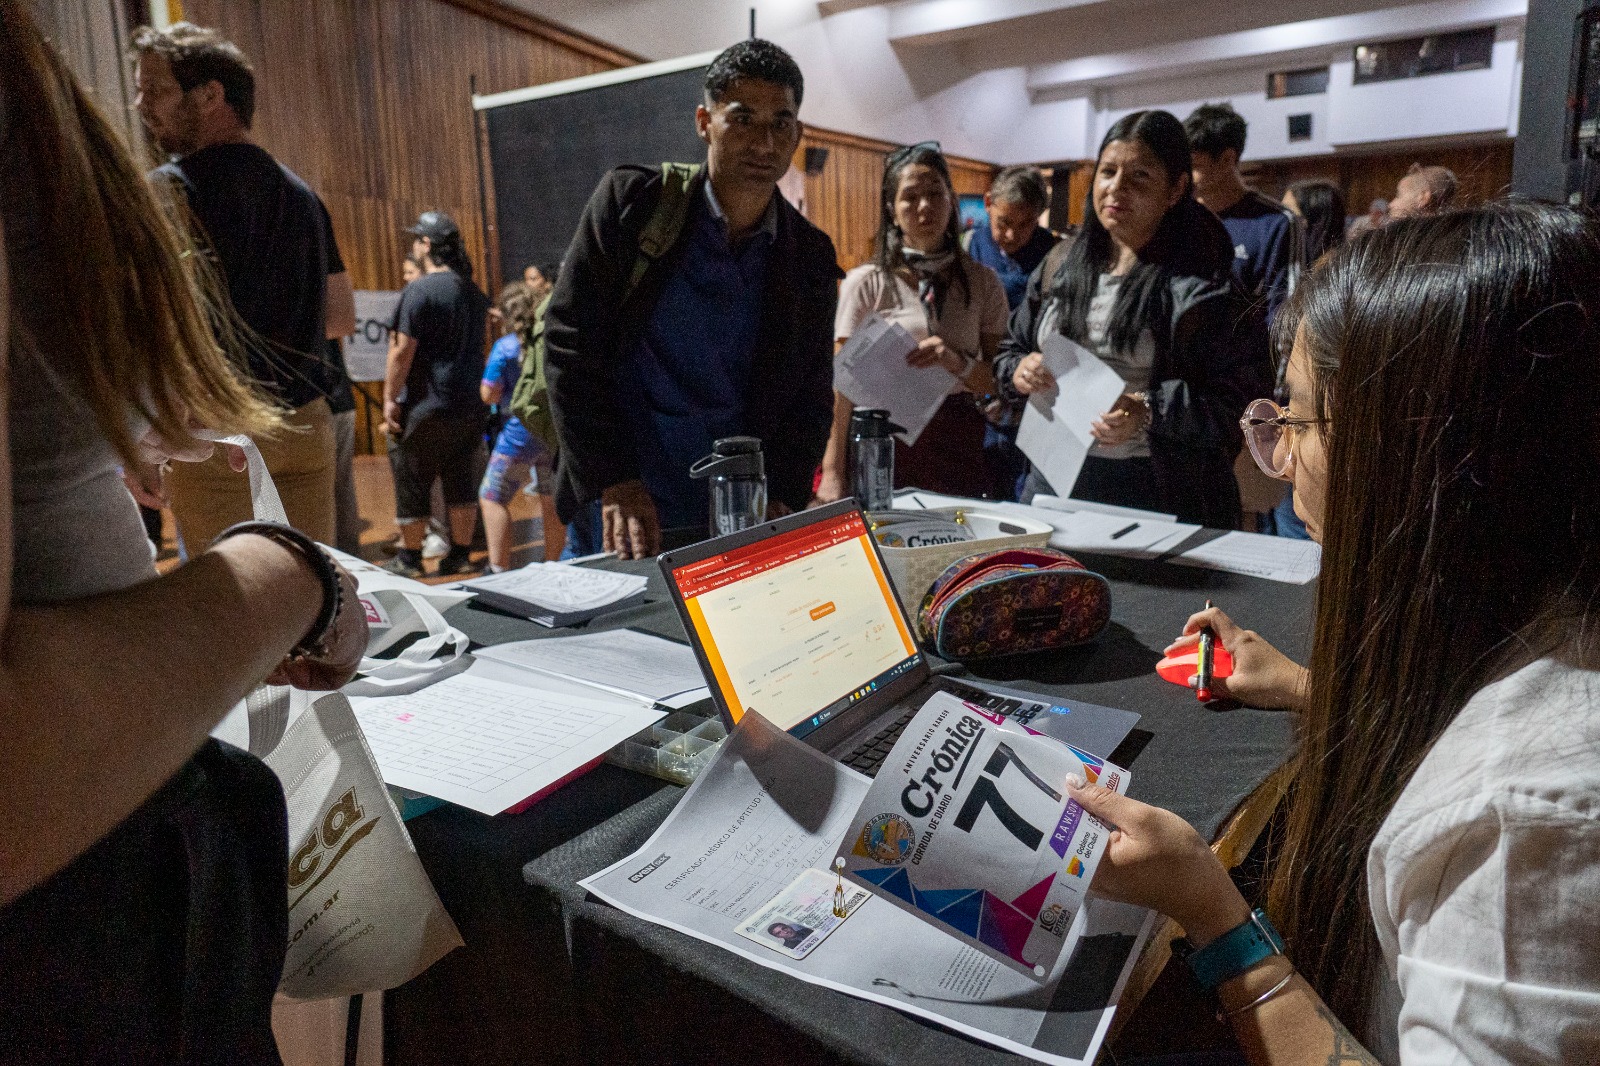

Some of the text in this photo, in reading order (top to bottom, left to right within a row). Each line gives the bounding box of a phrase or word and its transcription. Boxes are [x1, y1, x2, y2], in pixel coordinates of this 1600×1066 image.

[901, 715, 983, 818] Crónica
[903, 728, 936, 775] ANIVERSARIO
[953, 741, 1062, 852] 77
[1055, 802, 1078, 841] RAWSON
[664, 856, 707, 890] CERTIFICADO
[704, 833, 731, 857] MÉDICO
[727, 824, 740, 834] DE
[736, 797, 762, 826] APTITUD
[911, 794, 952, 866] CORRIDA DE DIARIO
[1077, 832, 1091, 855] Gobierno
[1087, 832, 1099, 850] Chubut
